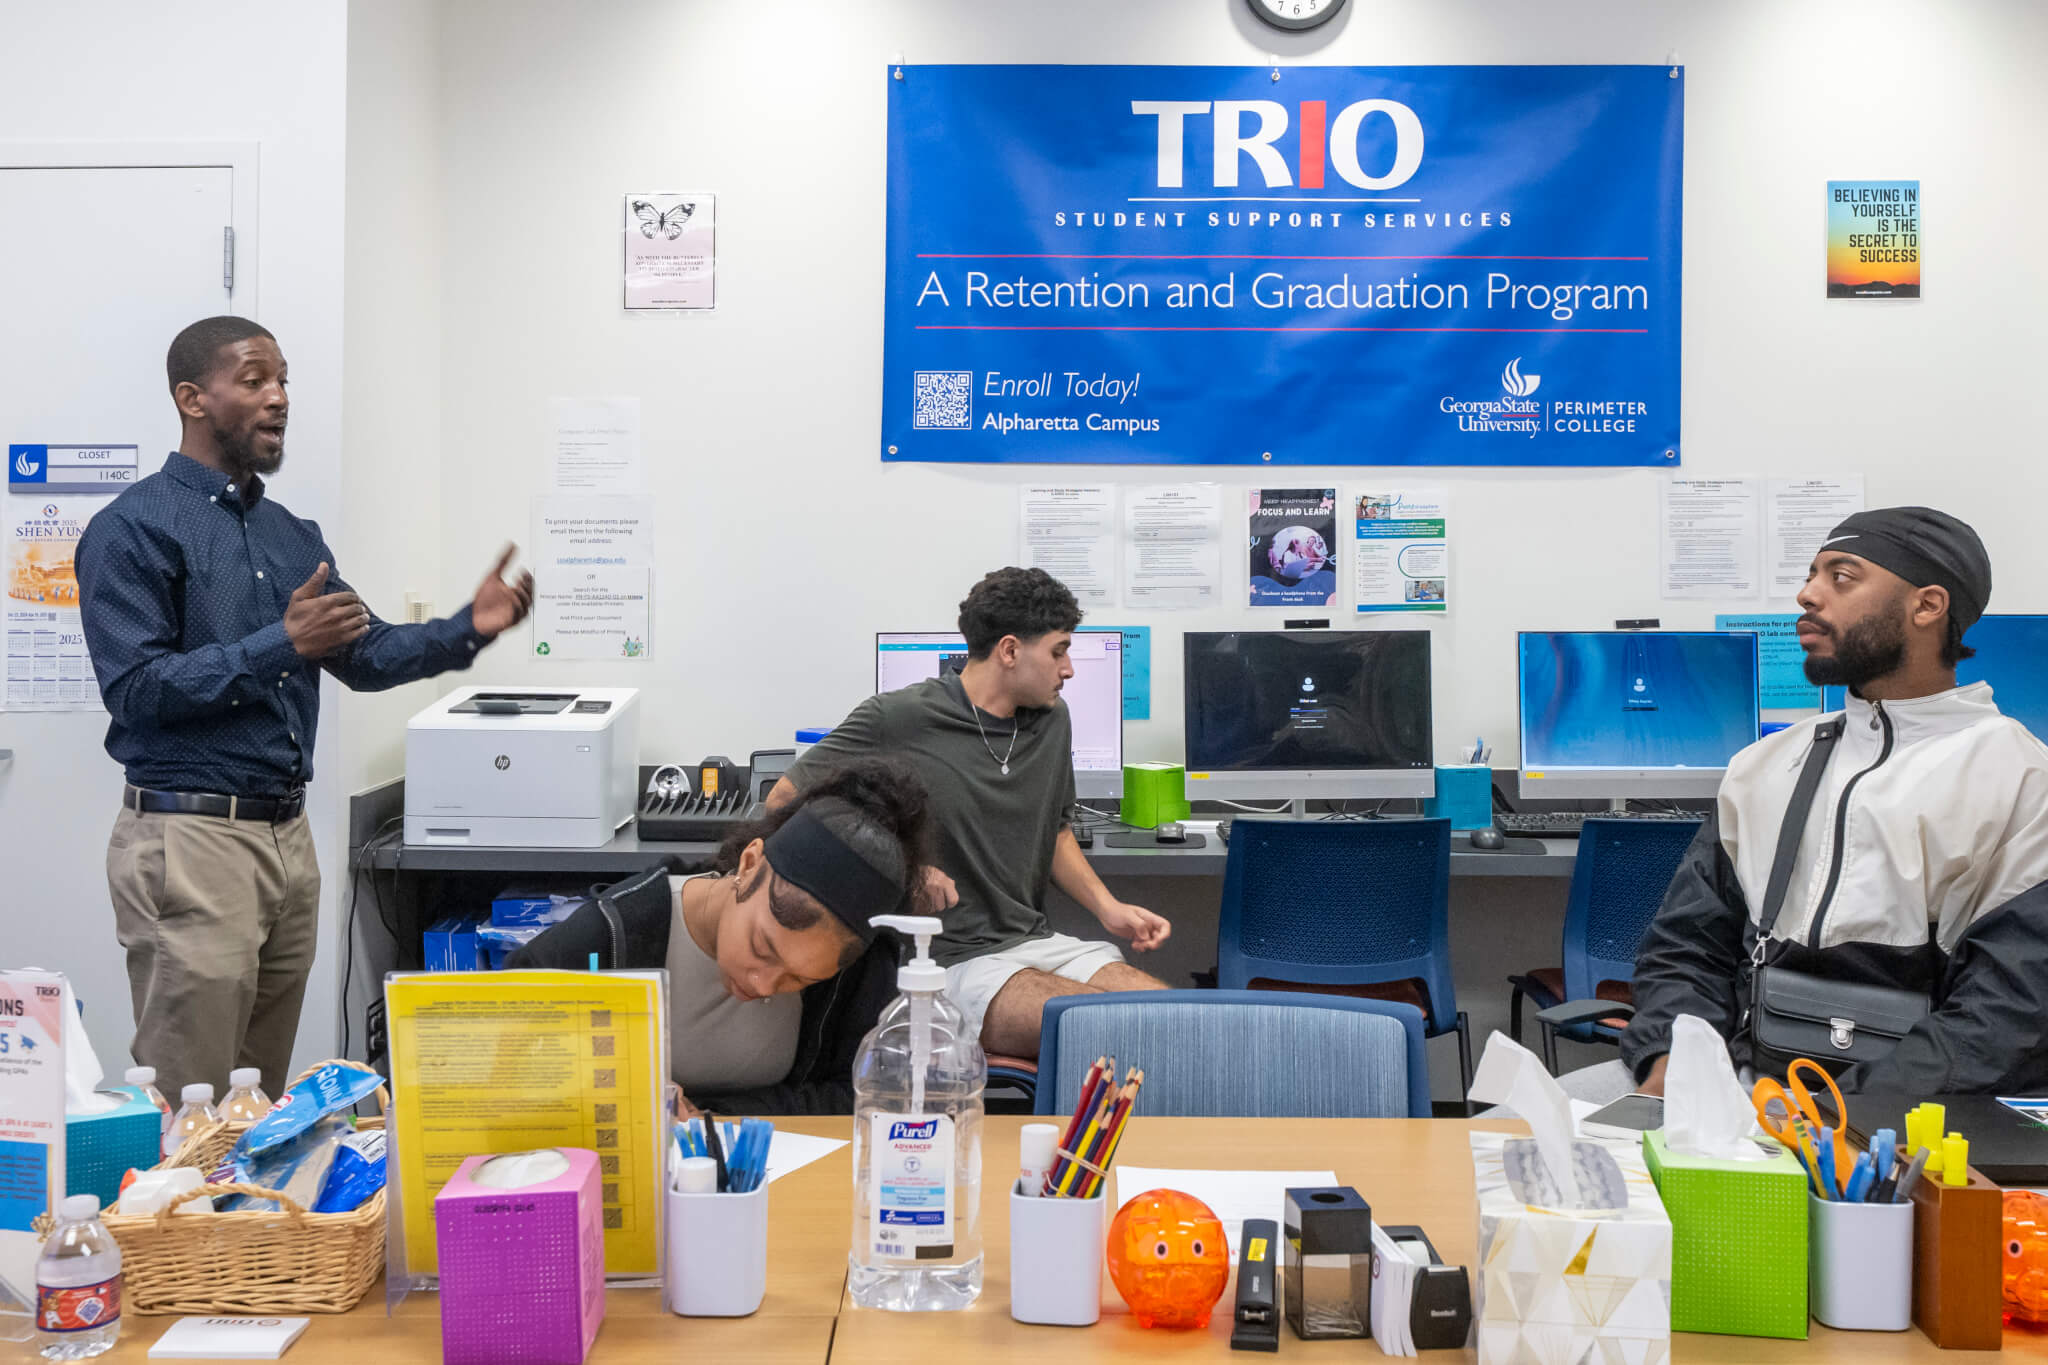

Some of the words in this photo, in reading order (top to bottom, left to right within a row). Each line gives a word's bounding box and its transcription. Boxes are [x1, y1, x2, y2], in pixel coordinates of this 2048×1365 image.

[1278, 1, 1284, 11] 7
[1293, 4, 1300, 15] 6
[1132, 99, 1424, 190] TRIO
[1834, 189, 1900, 203] BELIEVING
[1904, 188, 1917, 202] IN
[1852, 204, 1917, 218] YOURSELF
[1056, 212, 1185, 226] STUDENT
[1209, 212, 1341, 227] SUPPORT
[1365, 212, 1510, 228] SERVICES
[1877, 219, 1889, 233] IS
[1894, 219, 1917, 233] THE
[1849, 234, 1897, 248] SECRET
[1902, 234, 1917, 248] TO
[1860, 249, 1917, 263] SUCCESS
[917, 272, 949, 306] A
[967, 272, 1148, 307] Retention
[1167, 272, 1233, 307] and
[1252, 273, 1467, 308] Graduation
[1488, 273, 1647, 320] Program
[984, 372, 1052, 396] Enroll
[1064, 373, 1139, 404] Today!
[1556, 402, 1646, 414] PERIMETER
[983, 413, 1079, 434] Alpharetta
[1087, 414, 1159, 435] Campus
[1555, 420, 1634, 432] COLLEGE
[78, 451, 111, 460] CLOSET
[100, 470, 131, 482] 1140C
[1258, 508, 1284, 516] FOCUS
[1285, 508, 1302, 516] AND
[1304, 508, 1330, 516] LEARN
[16, 527, 53, 538] SHEN
[1726, 620, 1770, 628] Instructions
[59, 633, 84, 645] 2025
[35, 986, 61, 997] TRIO
[894, 1122, 935, 1139] Purell
